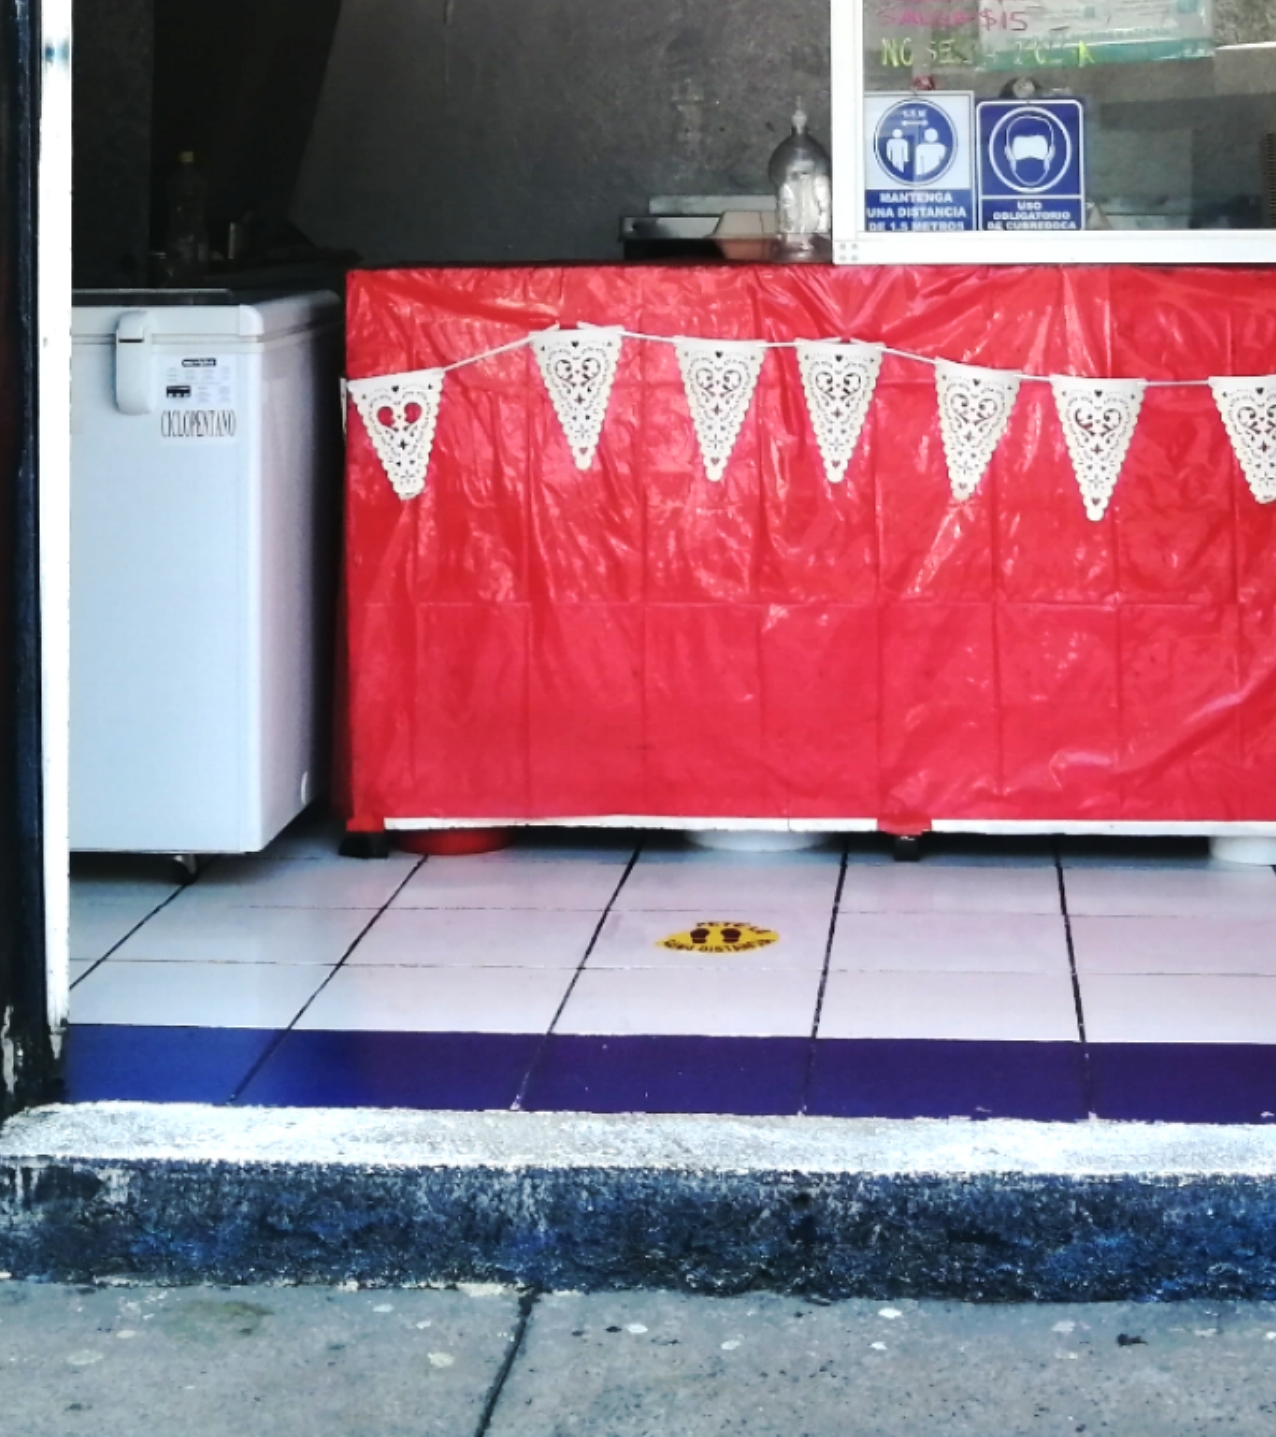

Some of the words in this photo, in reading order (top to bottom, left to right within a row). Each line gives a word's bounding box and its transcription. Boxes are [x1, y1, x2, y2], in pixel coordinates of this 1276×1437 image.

[982, 8, 1028, 31] $15
[879, 192, 953, 203] MANTENGA
[1017, 200, 1042, 210] USO
[867, 207, 894, 218] UNA
[897, 206, 967, 218] DISTANCIA
[993, 211, 1071, 220] OBLIGATORIO
[869, 221, 886, 231] DE
[911, 221, 965, 231] METROS
[161, 409, 236, 437] CICLOPENTANO
